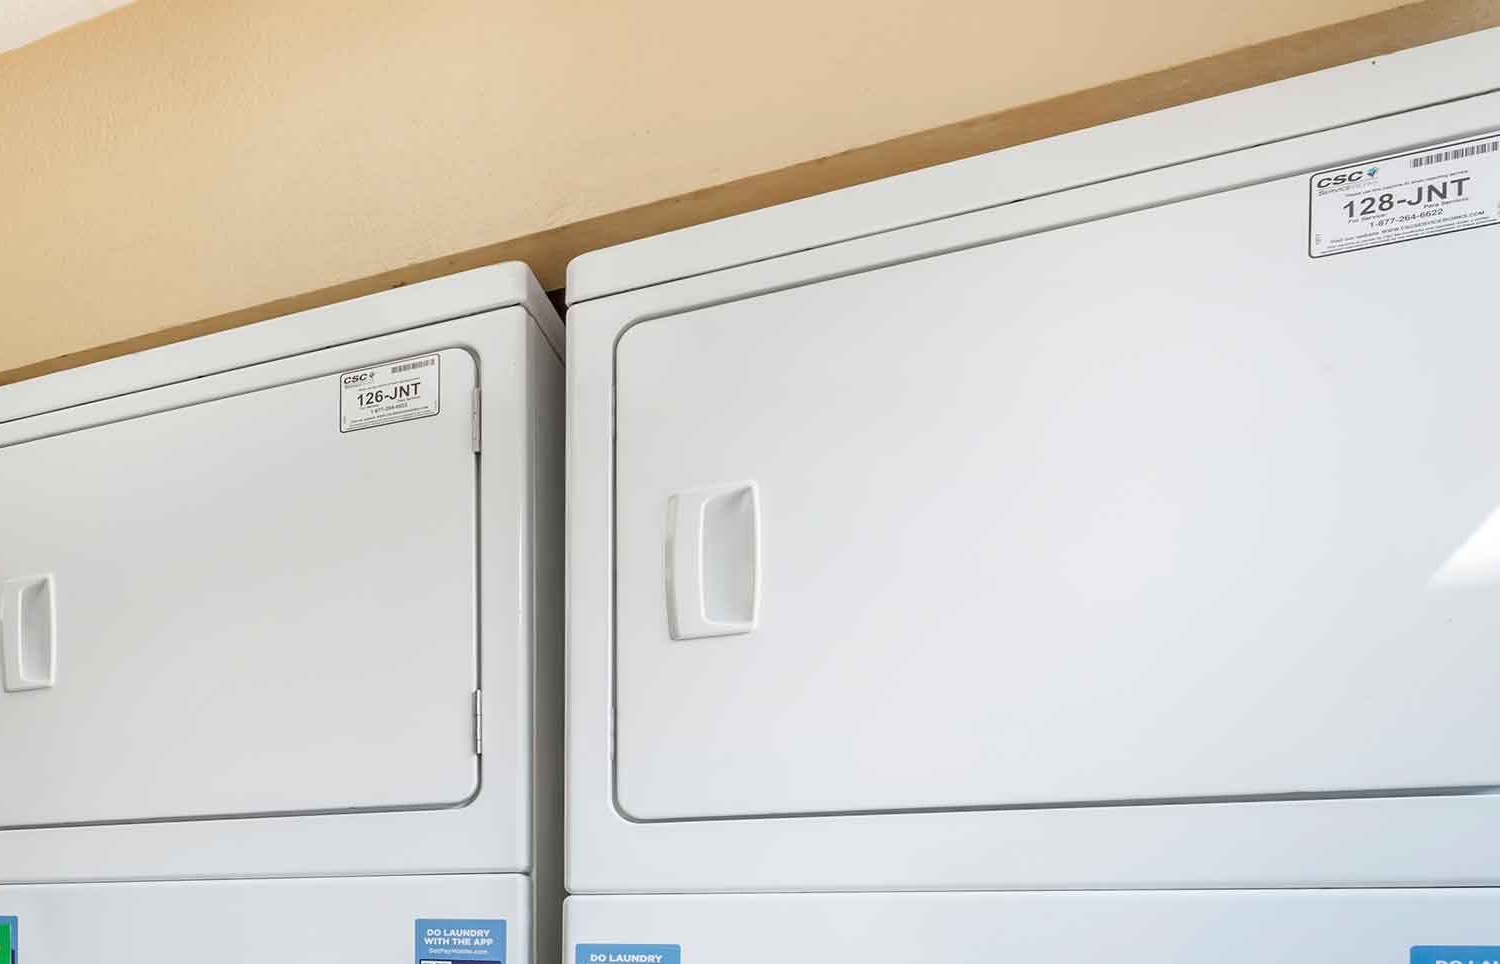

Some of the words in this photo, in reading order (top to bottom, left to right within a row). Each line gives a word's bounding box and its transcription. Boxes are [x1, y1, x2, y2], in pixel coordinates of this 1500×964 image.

[1317, 171, 1363, 188] CSC
[1342, 177, 1471, 218] 128-JNT
[1370, 208, 1444, 228] 1-877-264-6622
[343, 373, 368, 385] CSC
[357, 382, 421, 407] 126-JNT
[426, 928, 442, 937] DO
[444, 929, 491, 938] LAUNDRY
[451, 938, 472, 946] THE
[473, 938, 494, 946] APP
[590, 954, 607, 962] DO
[608, 954, 664, 964] LAUNDRY
